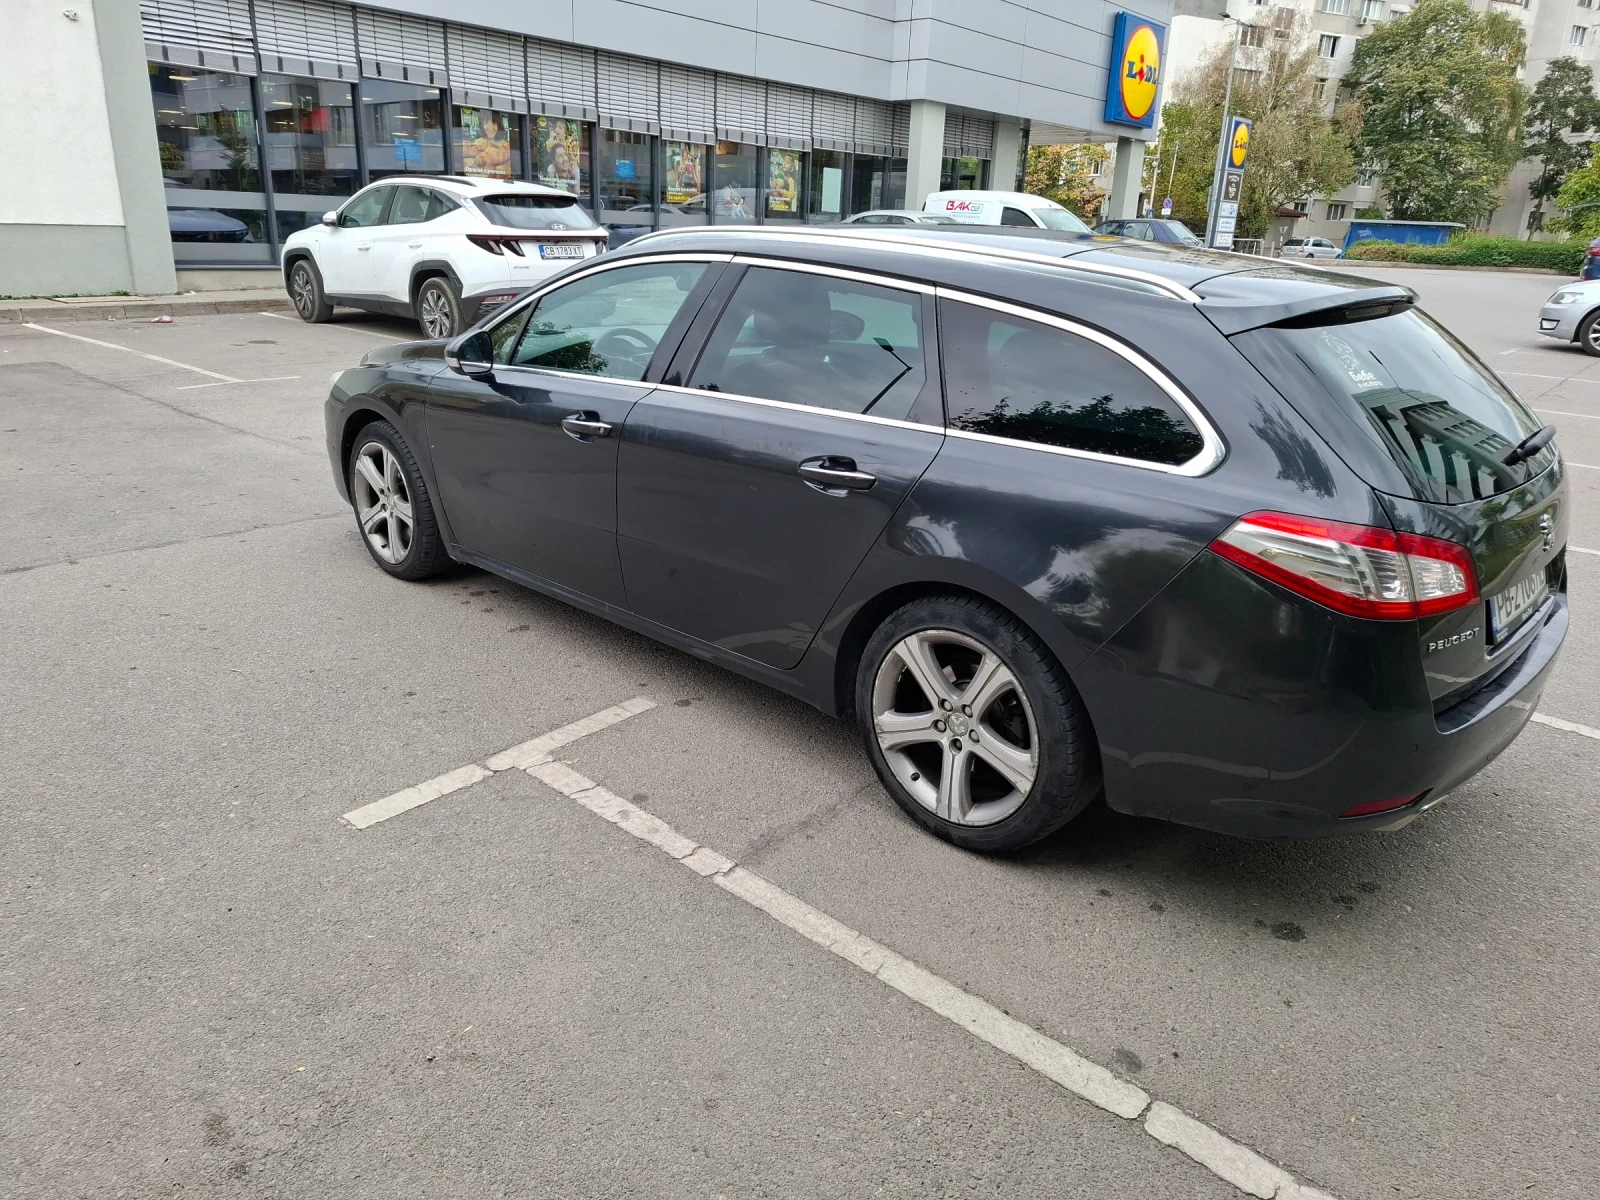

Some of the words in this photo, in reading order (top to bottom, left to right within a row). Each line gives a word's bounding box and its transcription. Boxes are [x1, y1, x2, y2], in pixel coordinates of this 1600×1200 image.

[545, 246, 555, 256] CB
[557, 246, 573, 256] 1783
[1428, 627, 1480, 652] PEUGEOT
